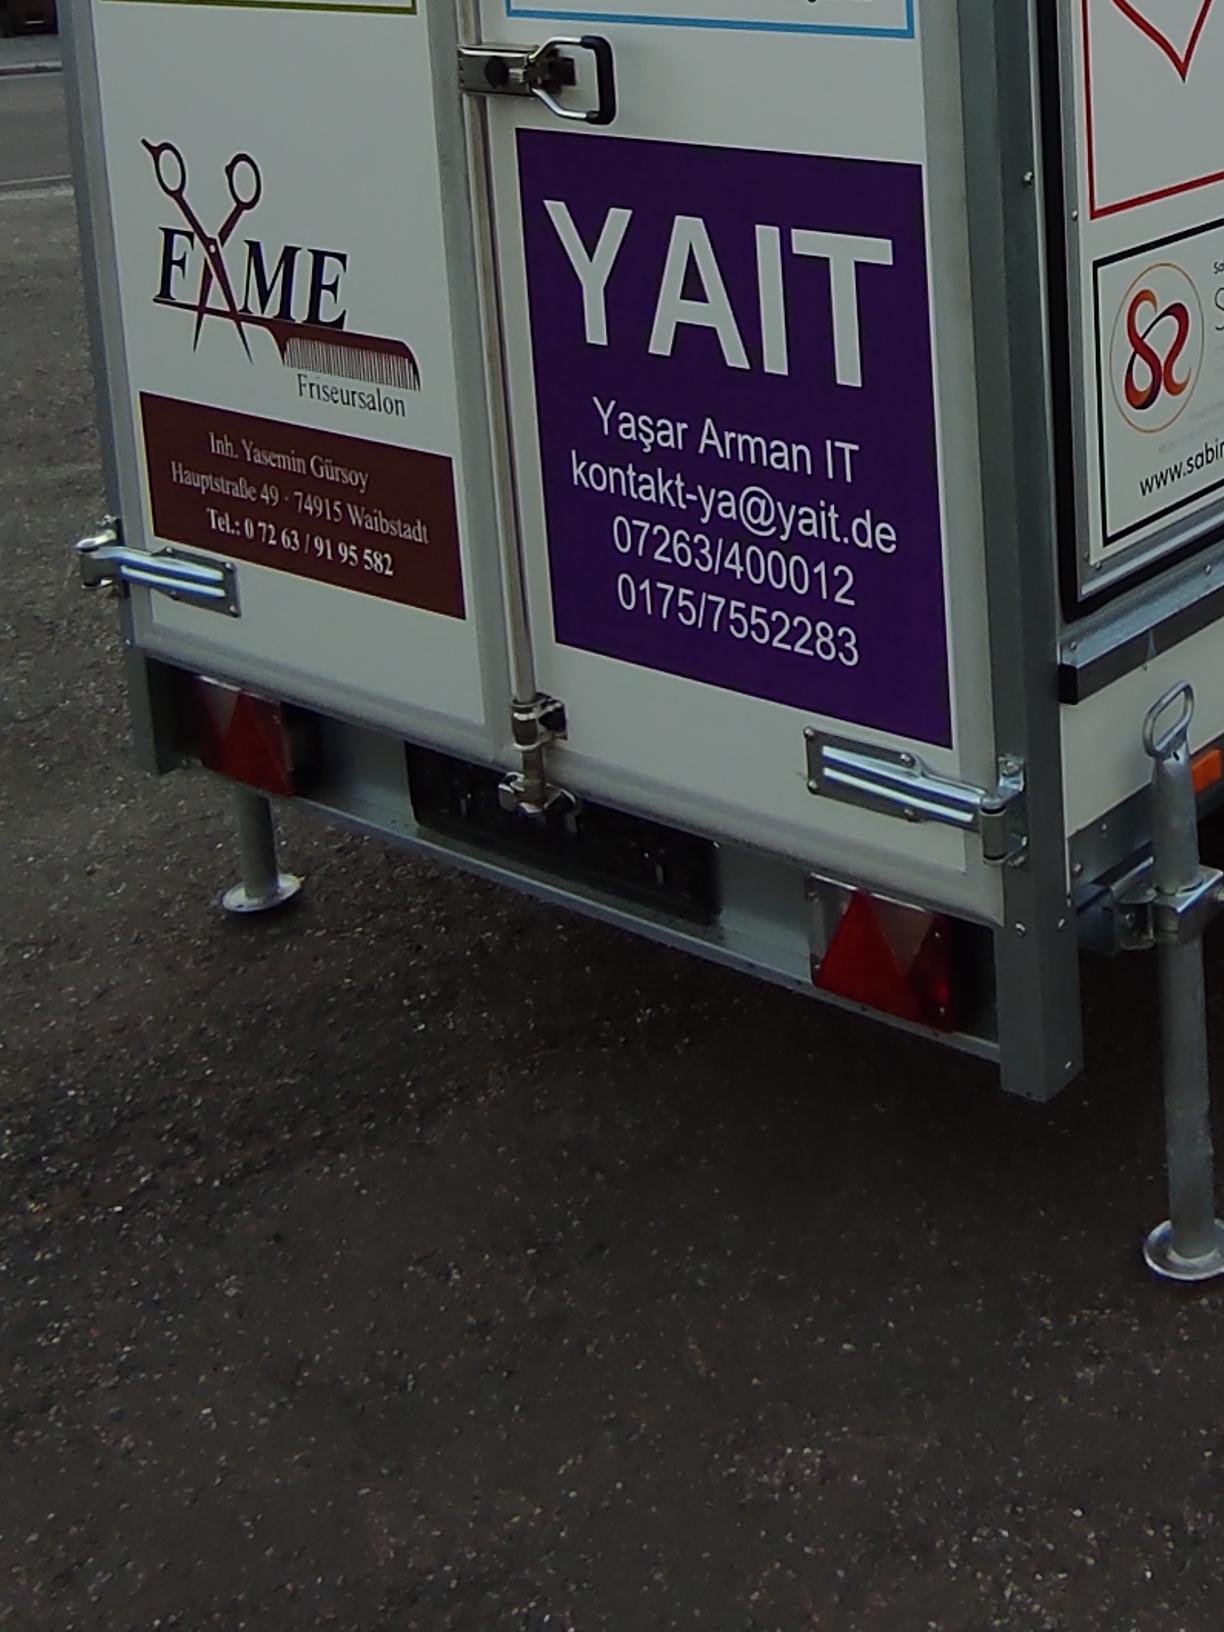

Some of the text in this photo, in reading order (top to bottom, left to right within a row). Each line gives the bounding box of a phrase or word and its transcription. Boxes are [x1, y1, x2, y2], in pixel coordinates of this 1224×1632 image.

[543, 199, 893, 387] YAIT
[297, 374, 406, 418] Friseursalon
[592, 396, 859, 483] Yaşar Arman IT
[171, 461, 430, 544] Hauptstraße 49 74915 Waibstadt
[208, 432, 369, 494] Inh. Yasemin Gürsoy
[571, 449, 897, 554] kontakt-ya@yait.de
[207, 508, 394, 577] Tel.: 0 72 63 91 95 582
[612, 515, 856, 606] 07263/400012
[617, 573, 860, 667] 0175/7552283
